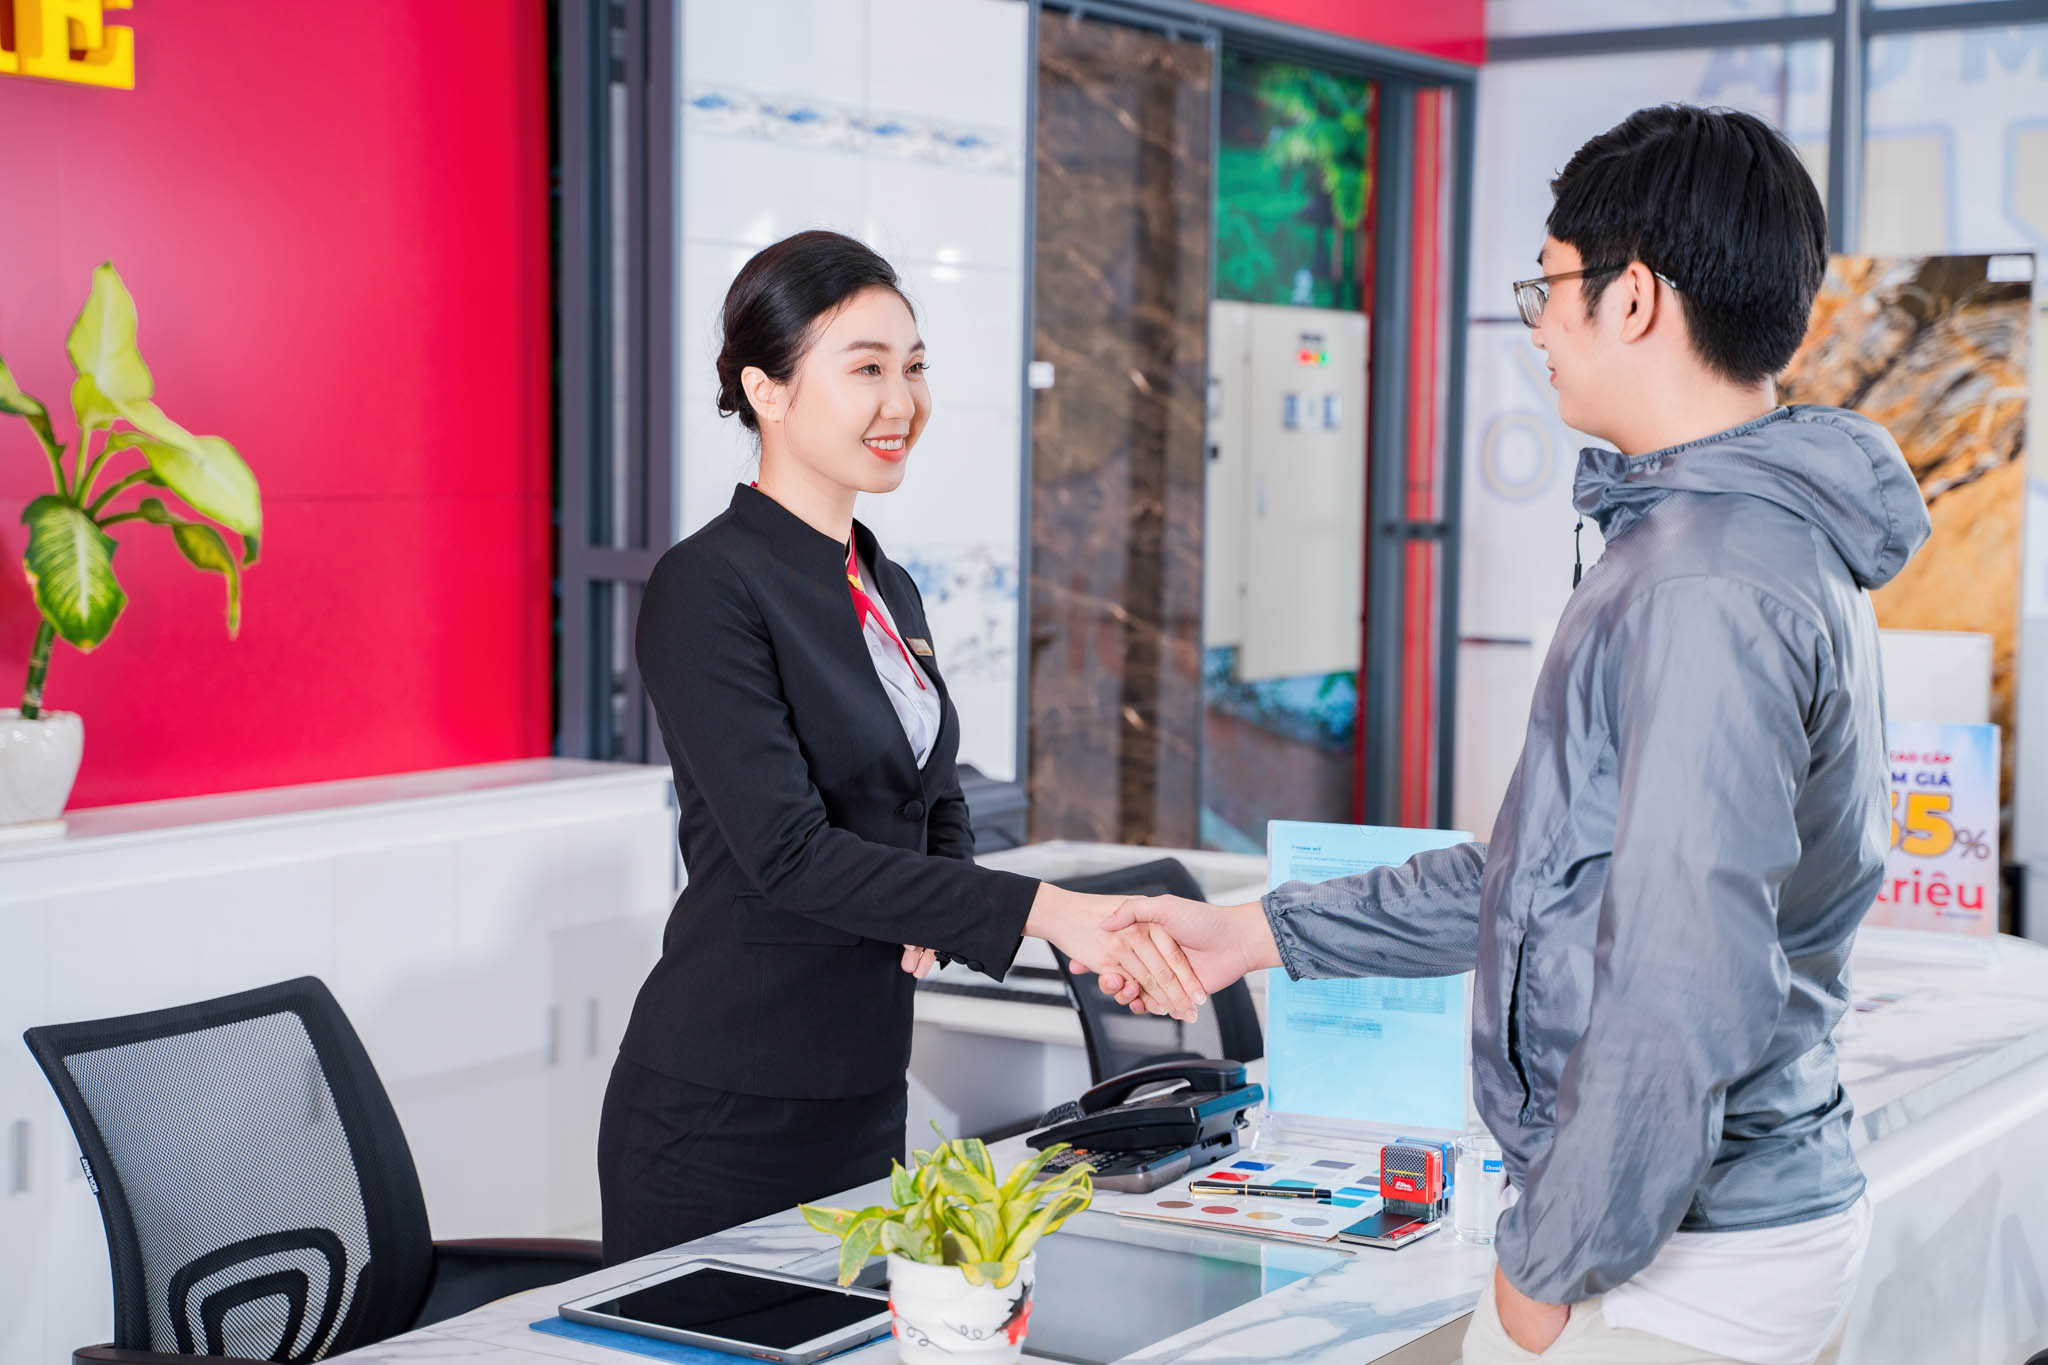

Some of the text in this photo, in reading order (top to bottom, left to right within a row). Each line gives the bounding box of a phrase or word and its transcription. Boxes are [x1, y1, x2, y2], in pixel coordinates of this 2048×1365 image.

[0, 0, 135, 90] E
[1915, 771, 1952, 786] GIÁ
[1890, 790, 1989, 859] 5%
